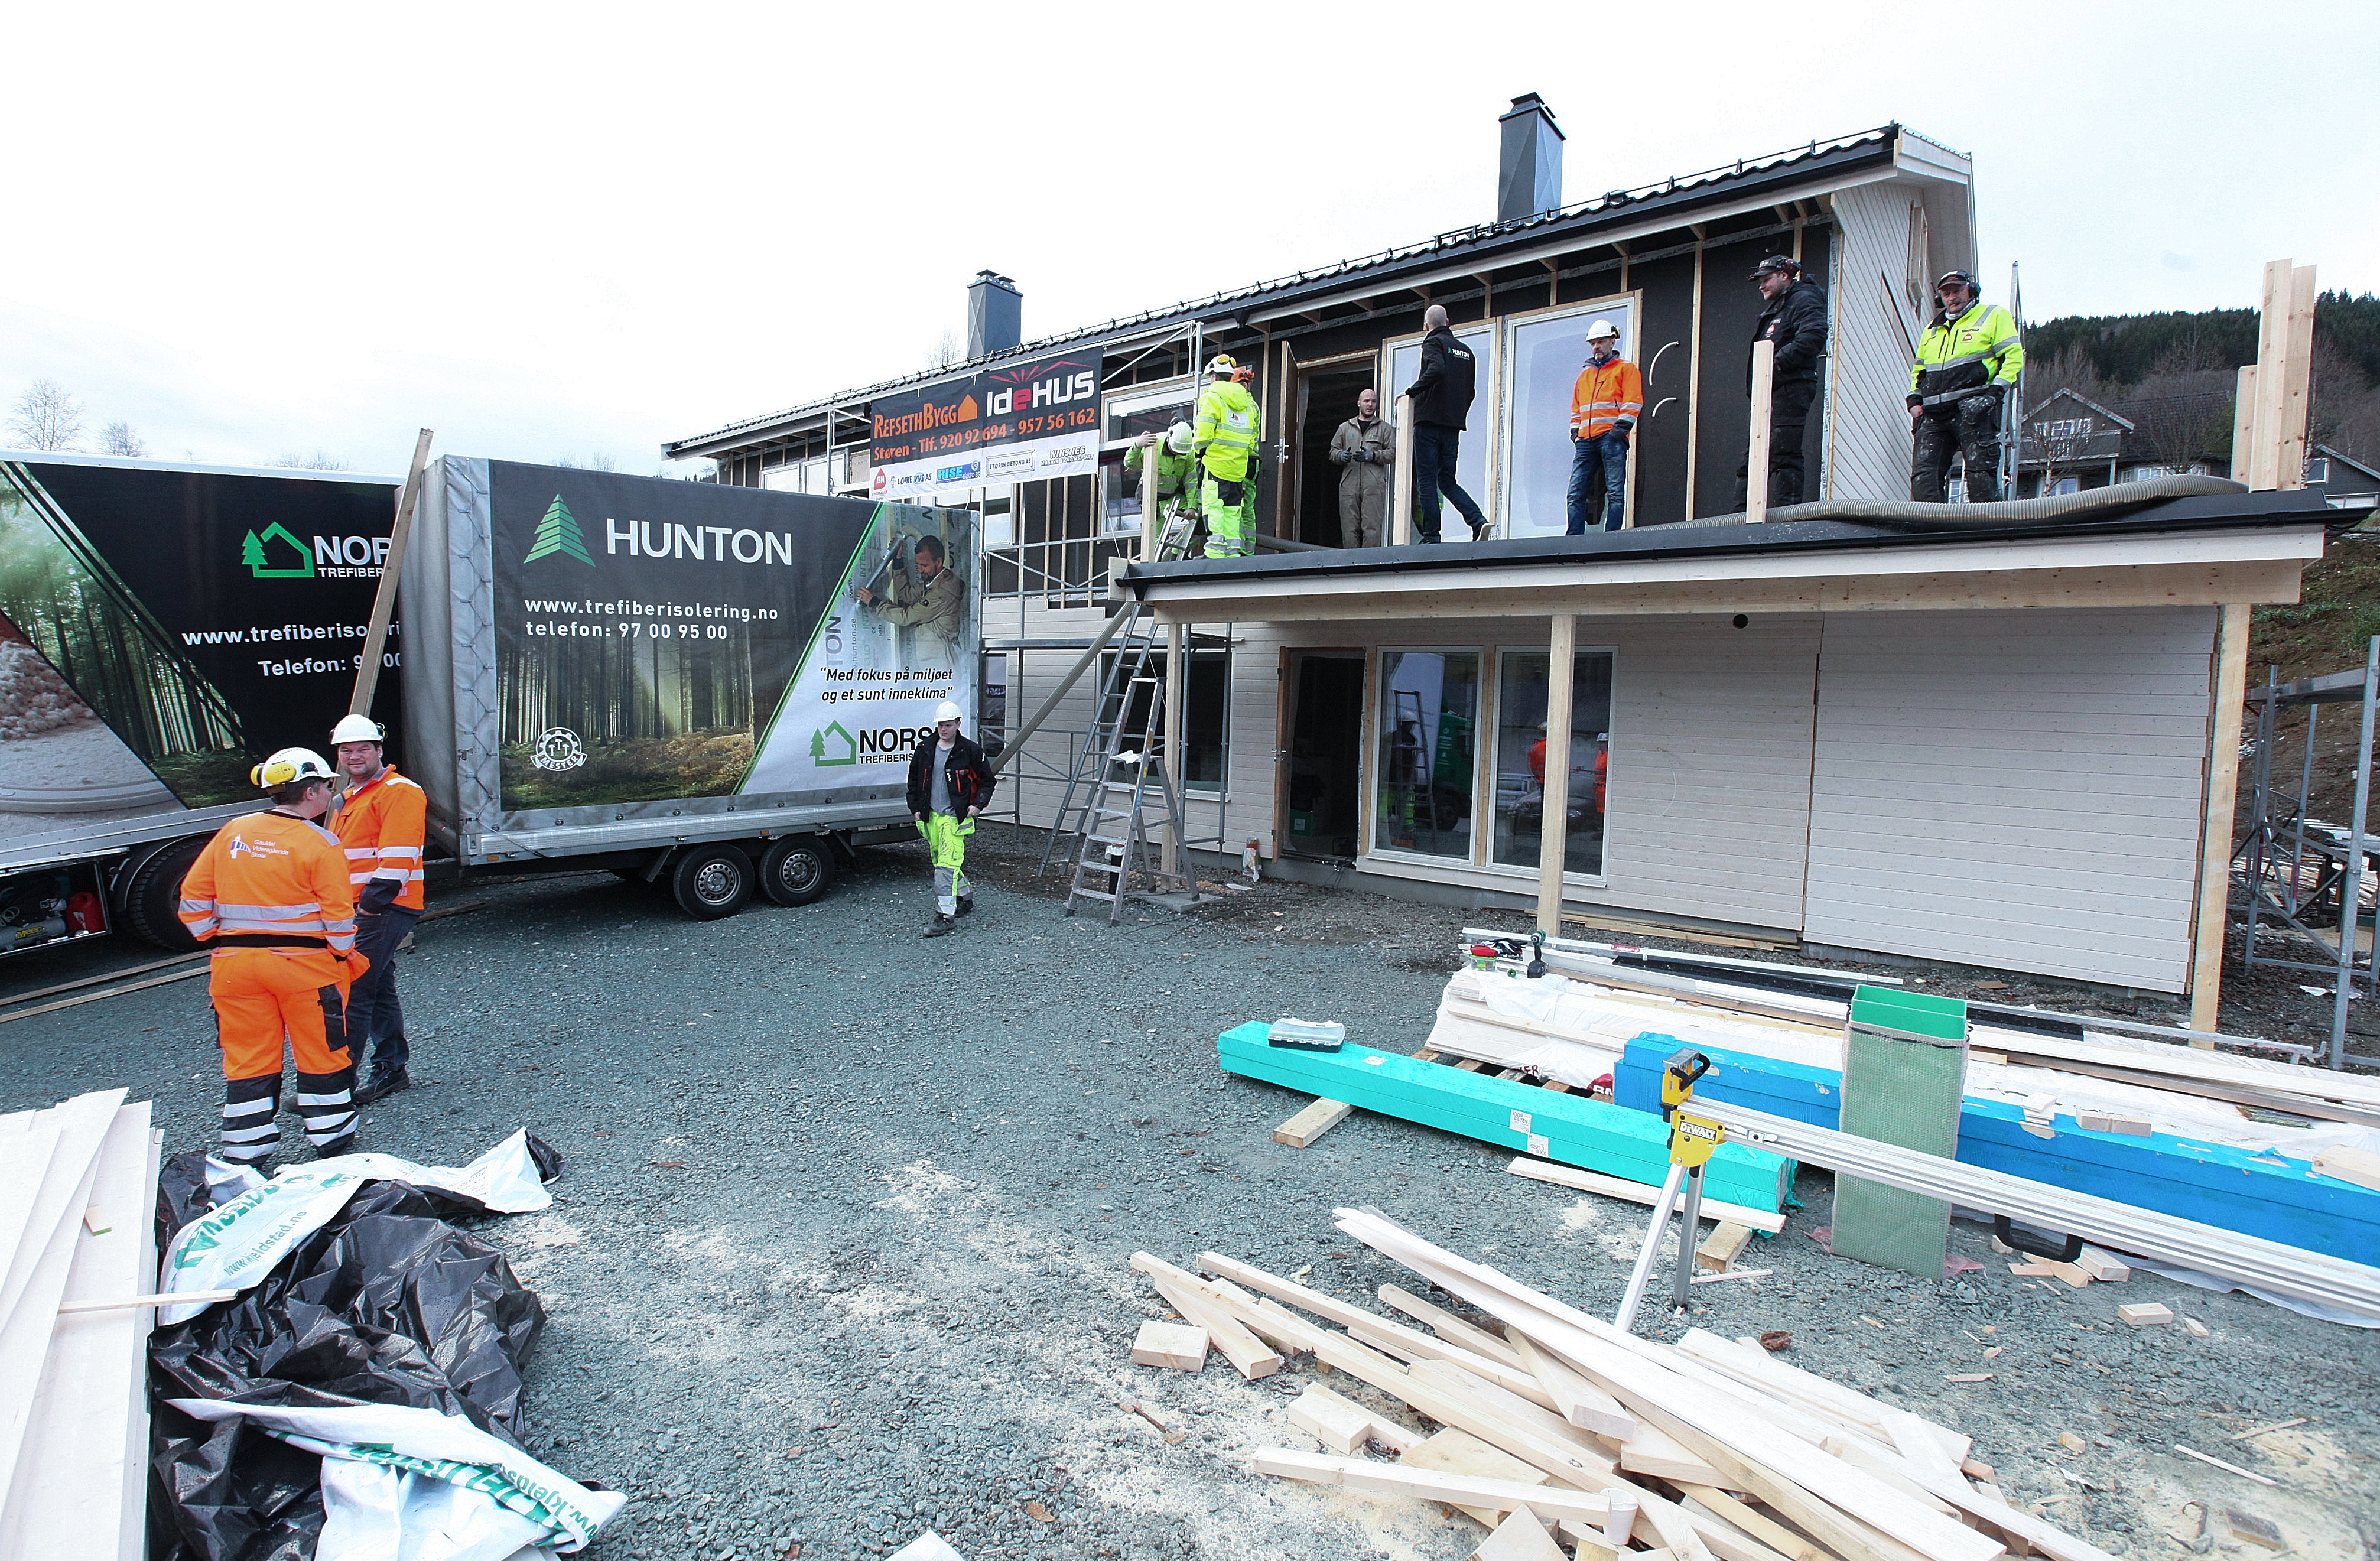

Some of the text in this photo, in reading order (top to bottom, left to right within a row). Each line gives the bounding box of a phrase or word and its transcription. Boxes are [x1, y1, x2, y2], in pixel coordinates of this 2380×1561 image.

[874, 443, 910, 461] Støren
[919, 435, 938, 452] Tlf.
[940, 432, 963, 450] 920
[965, 428, 980, 444] 92
[982, 424, 1007, 441] 694
[1019, 418, 1043, 435] 957
[1046, 414, 1064, 431] 56
[1068, 407, 1095, 427] 162
[1040, 458, 1059, 467] MASKIN
[1064, 454, 1095, 463] TRANSPORT
[1049, 445, 1086, 459] WINSNES
[913, 473, 924, 483] VVS
[925, 473, 932, 482] AS
[938, 466, 963, 480] RISE
[607, 518, 792, 565] HUNTON
[524, 600, 778, 622] www.trefiberisolering.no
[526, 621, 727, 639] telefon: 97 00 95 00
[258, 658, 346, 677] Telefon:
[857, 668, 891, 682] fokus
[895, 666, 909, 684] på
[912, 668, 952, 683] miljøet
[822, 690, 837, 704] og
[840, 688, 854, 700] et
[858, 688, 886, 701] sunt
[540, 755, 579, 769] MESTER
